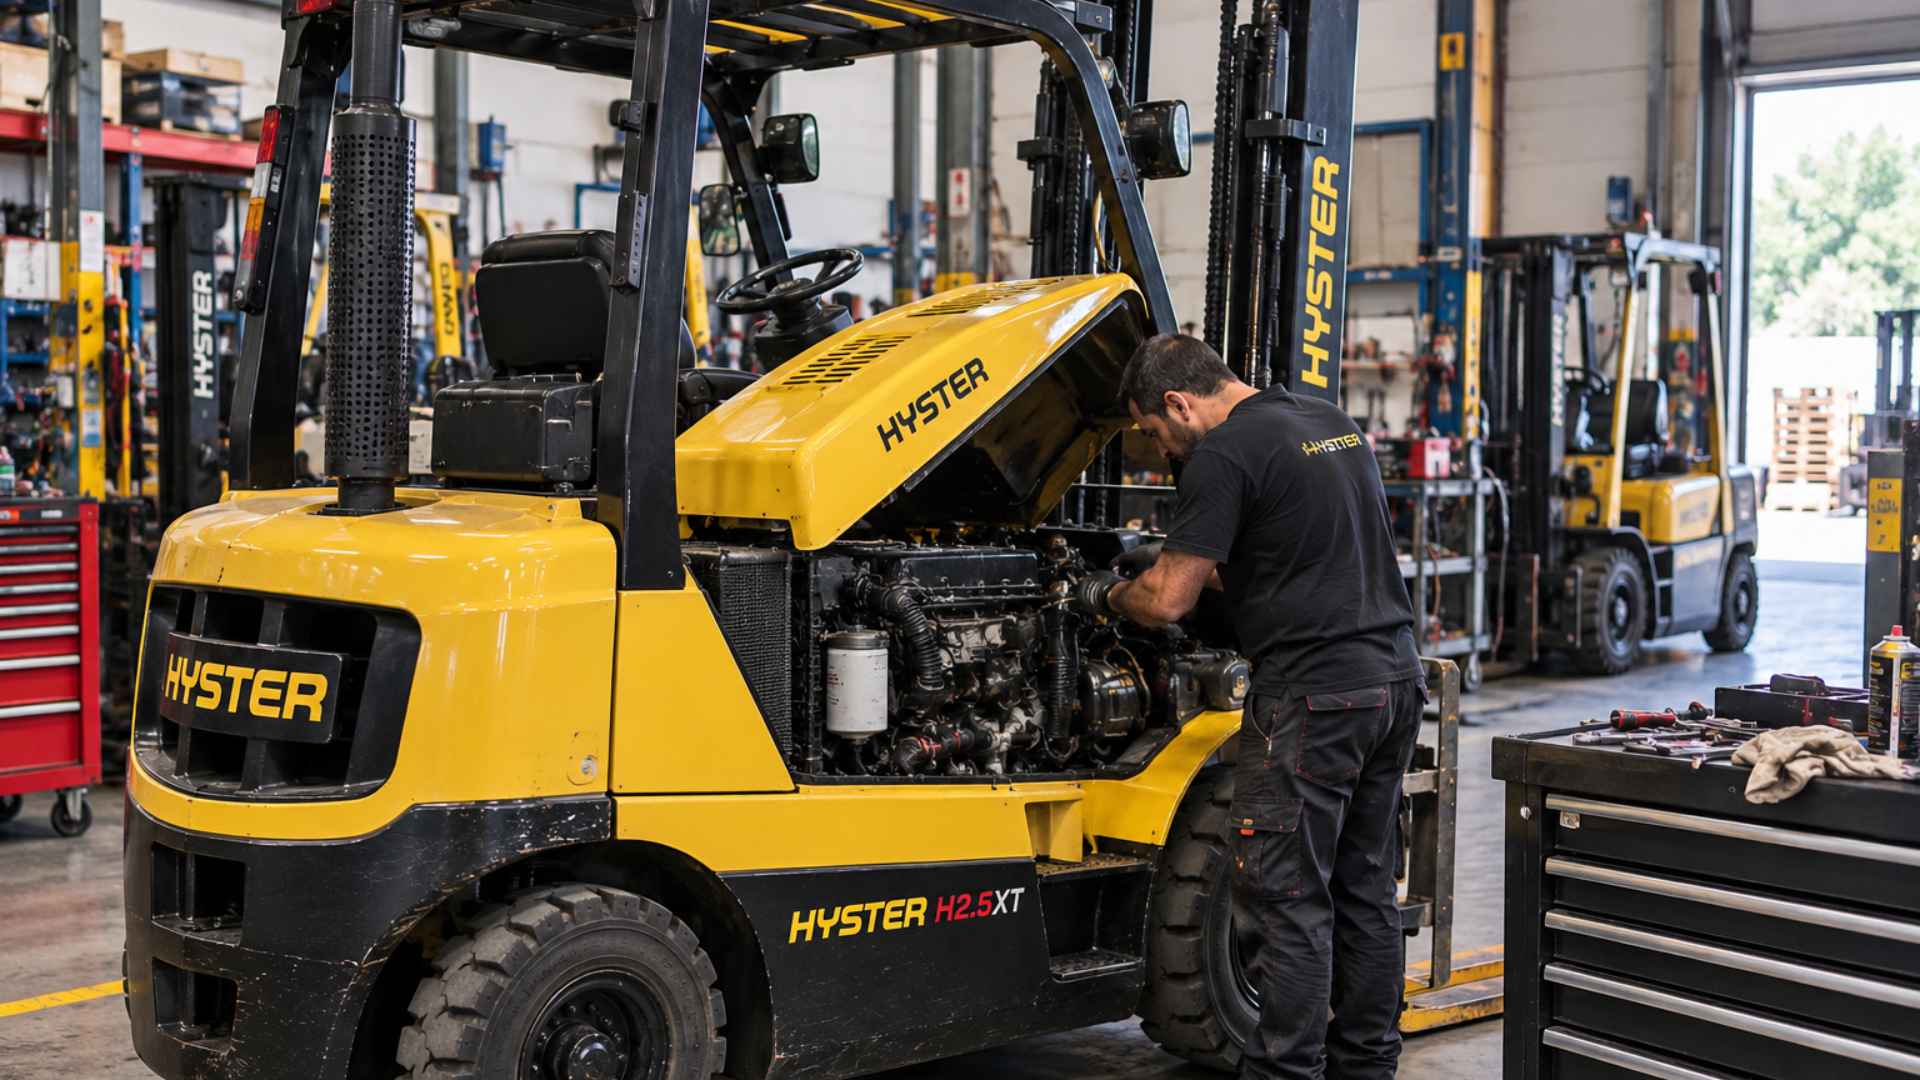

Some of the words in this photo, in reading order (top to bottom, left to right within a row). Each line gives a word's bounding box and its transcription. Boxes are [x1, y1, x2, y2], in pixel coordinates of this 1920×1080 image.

[1302, 155, 1340, 389] HYSTER
[192, 269, 214, 400] HYSTER
[876, 357, 990, 453] HYSTER
[164, 653, 328, 722] HYSTER
[788, 896, 928, 944] HYSTER
[934, 886, 1025, 924] H2.5XT
